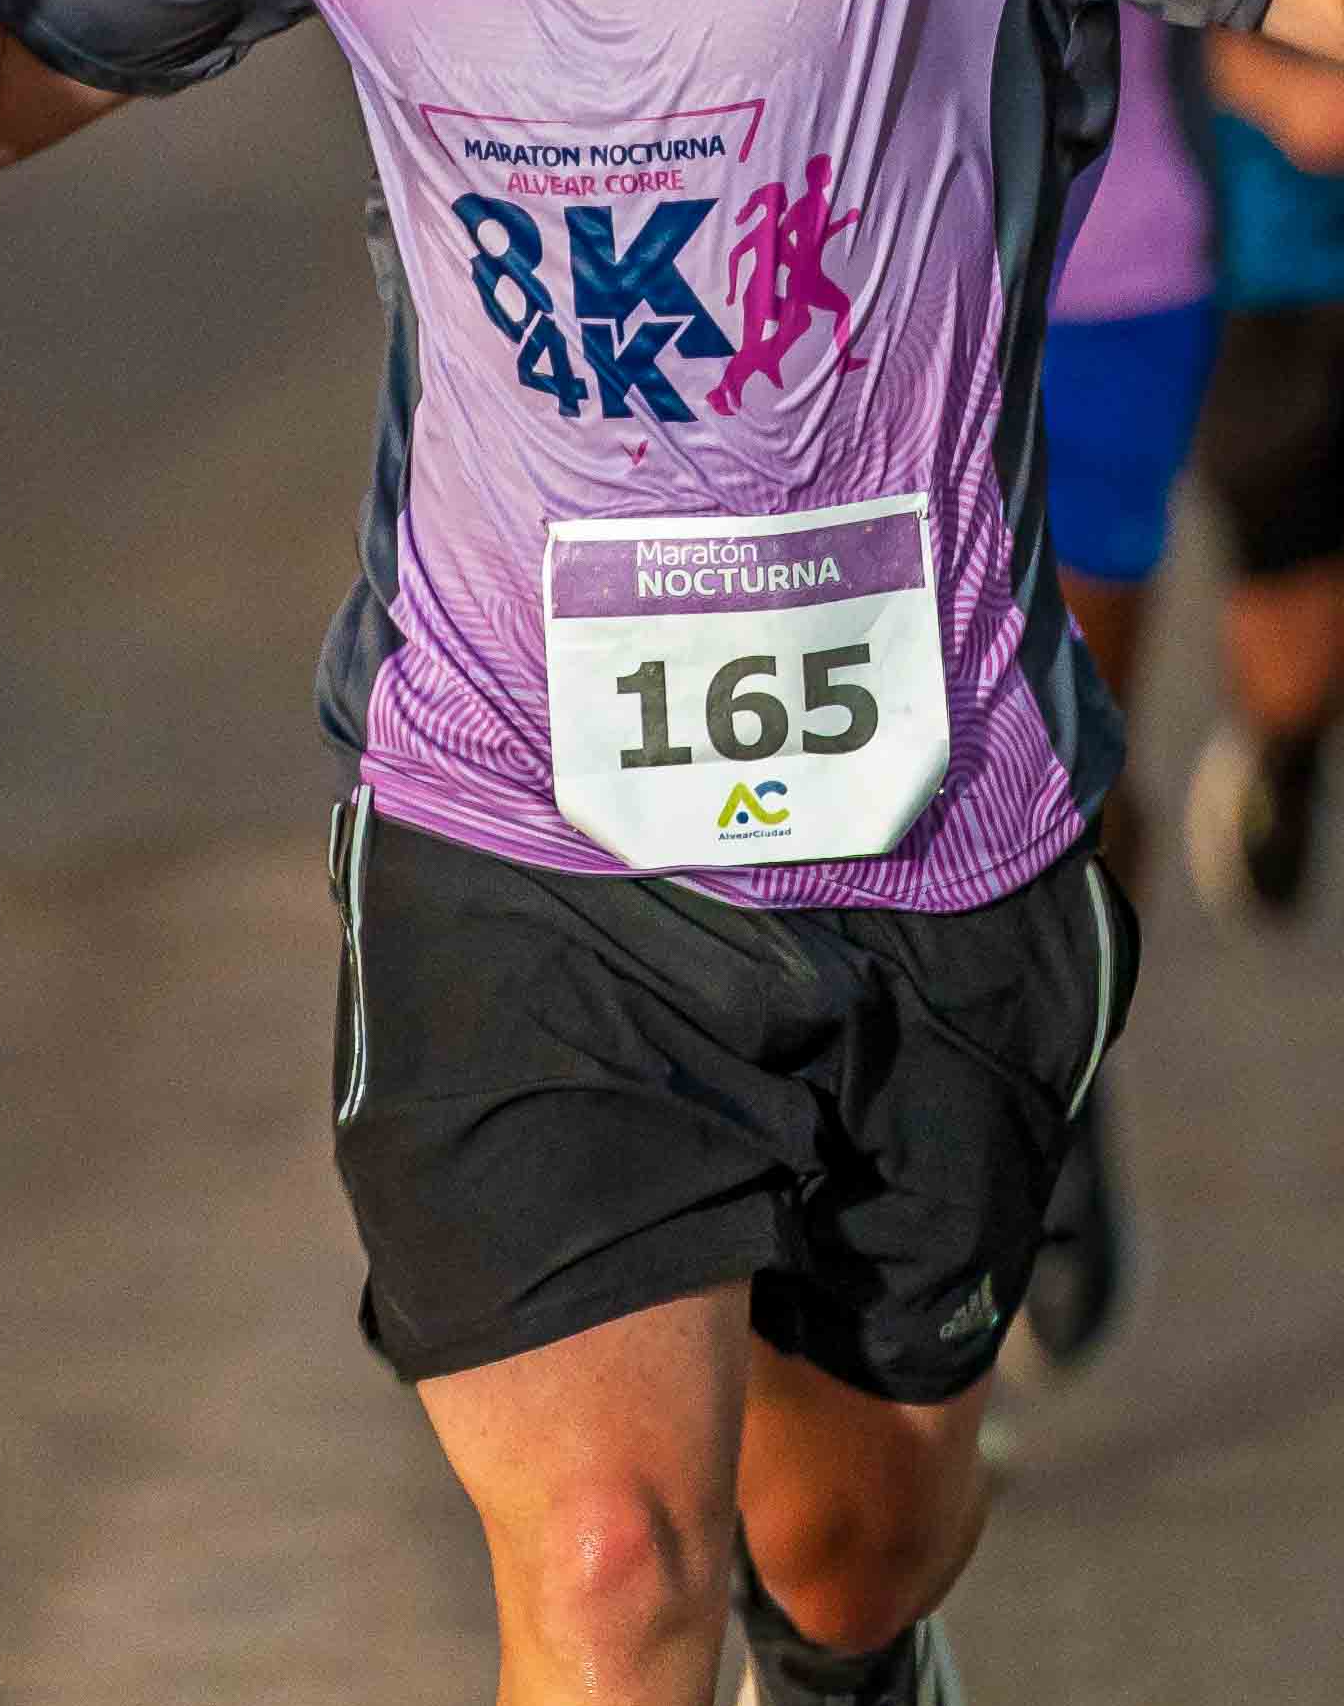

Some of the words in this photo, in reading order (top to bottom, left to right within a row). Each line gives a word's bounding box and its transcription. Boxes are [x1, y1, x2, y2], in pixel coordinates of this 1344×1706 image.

[464, 138, 581, 167] MARATON
[590, 135, 726, 167] NOCTURNA
[508, 171, 598, 196] ALVEAR
[605, 170, 685, 194] CORRE
[451, 192, 738, 359] 8K
[516, 312, 699, 422] 4K
[636, 537, 758, 567] Maratón
[637, 557, 841, 598] NOCTURNA
[616, 643, 879, 770] 165
